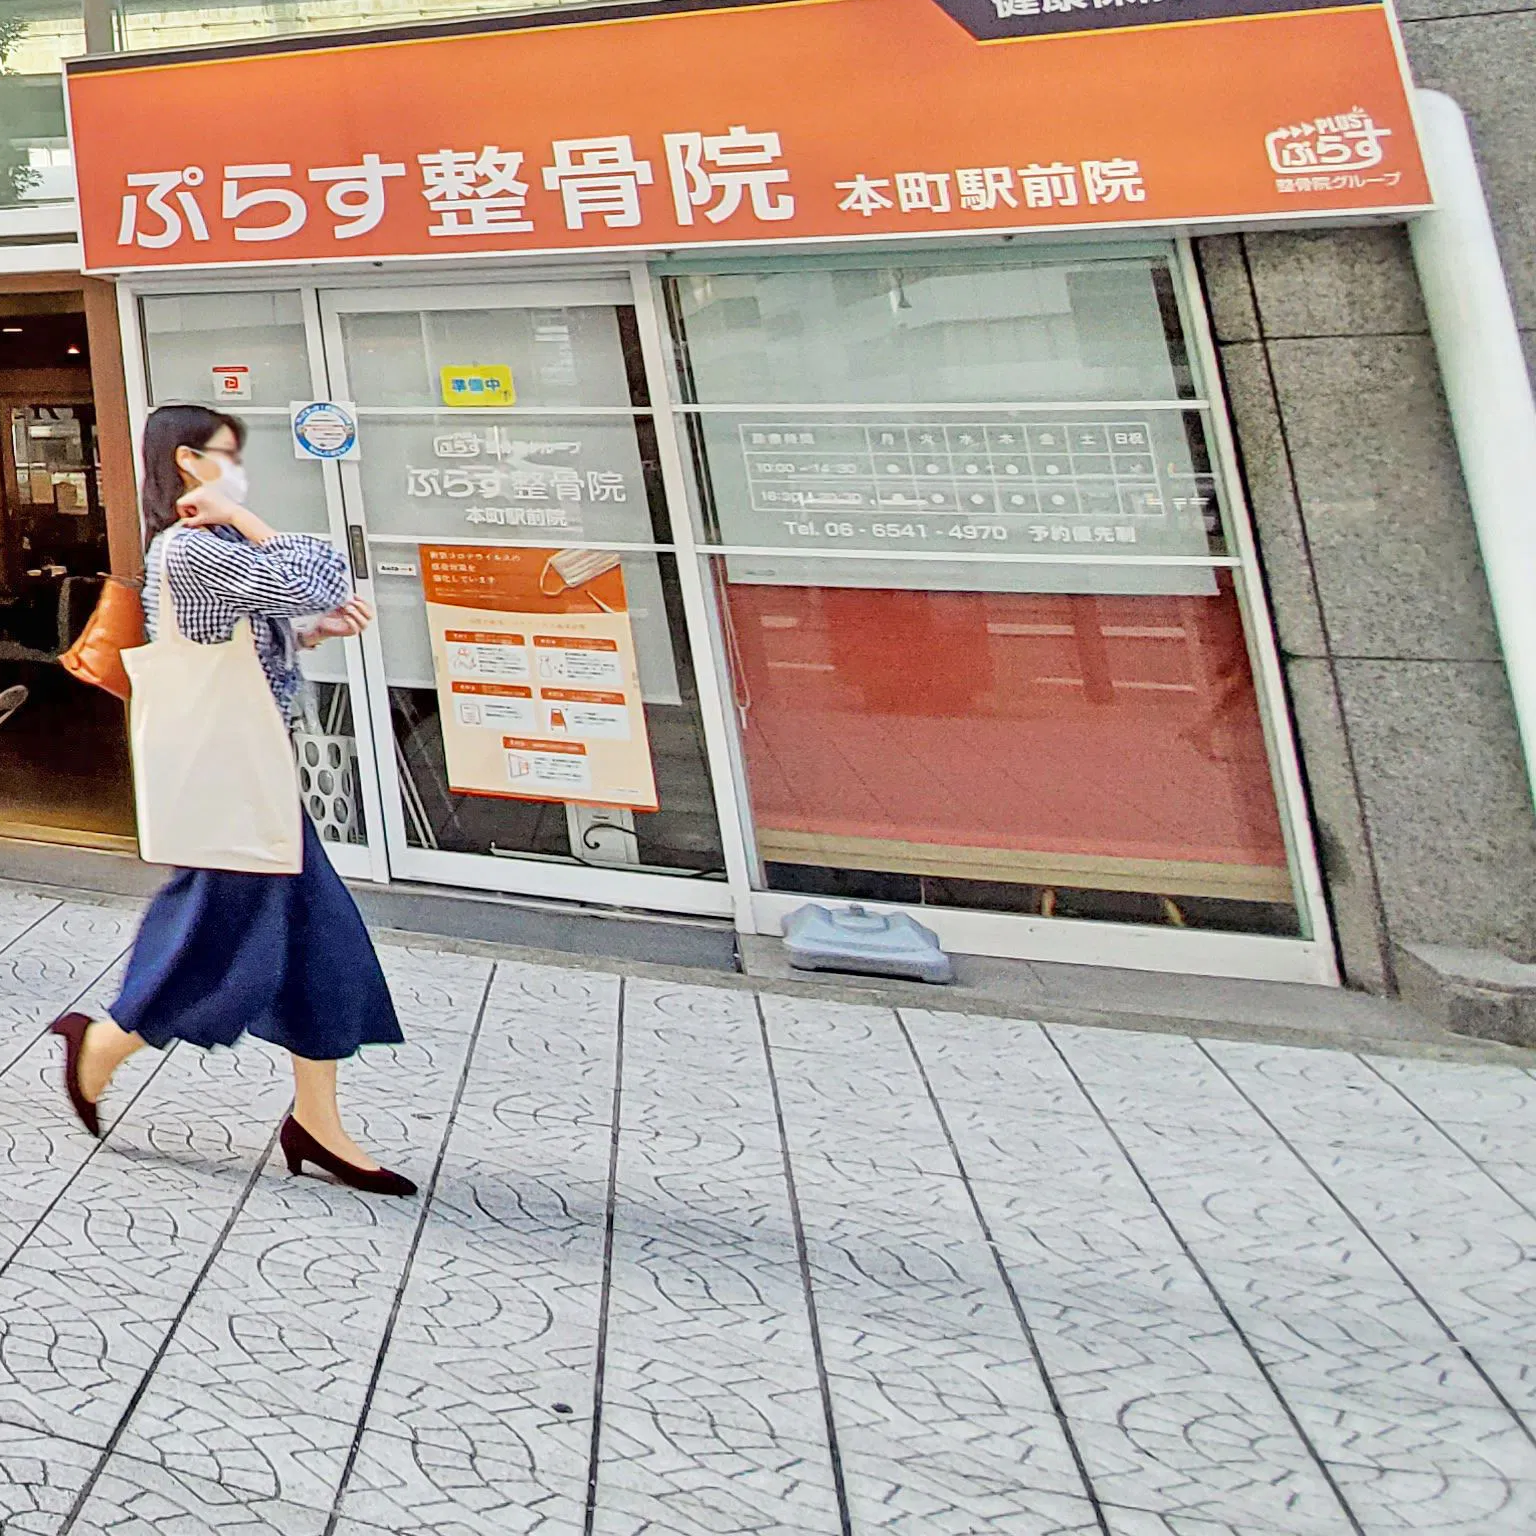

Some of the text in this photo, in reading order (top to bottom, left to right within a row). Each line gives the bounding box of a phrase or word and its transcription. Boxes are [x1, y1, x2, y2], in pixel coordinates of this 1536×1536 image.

[117, 125, 1146, 250] ぷらす整骨院 本町駅前院
